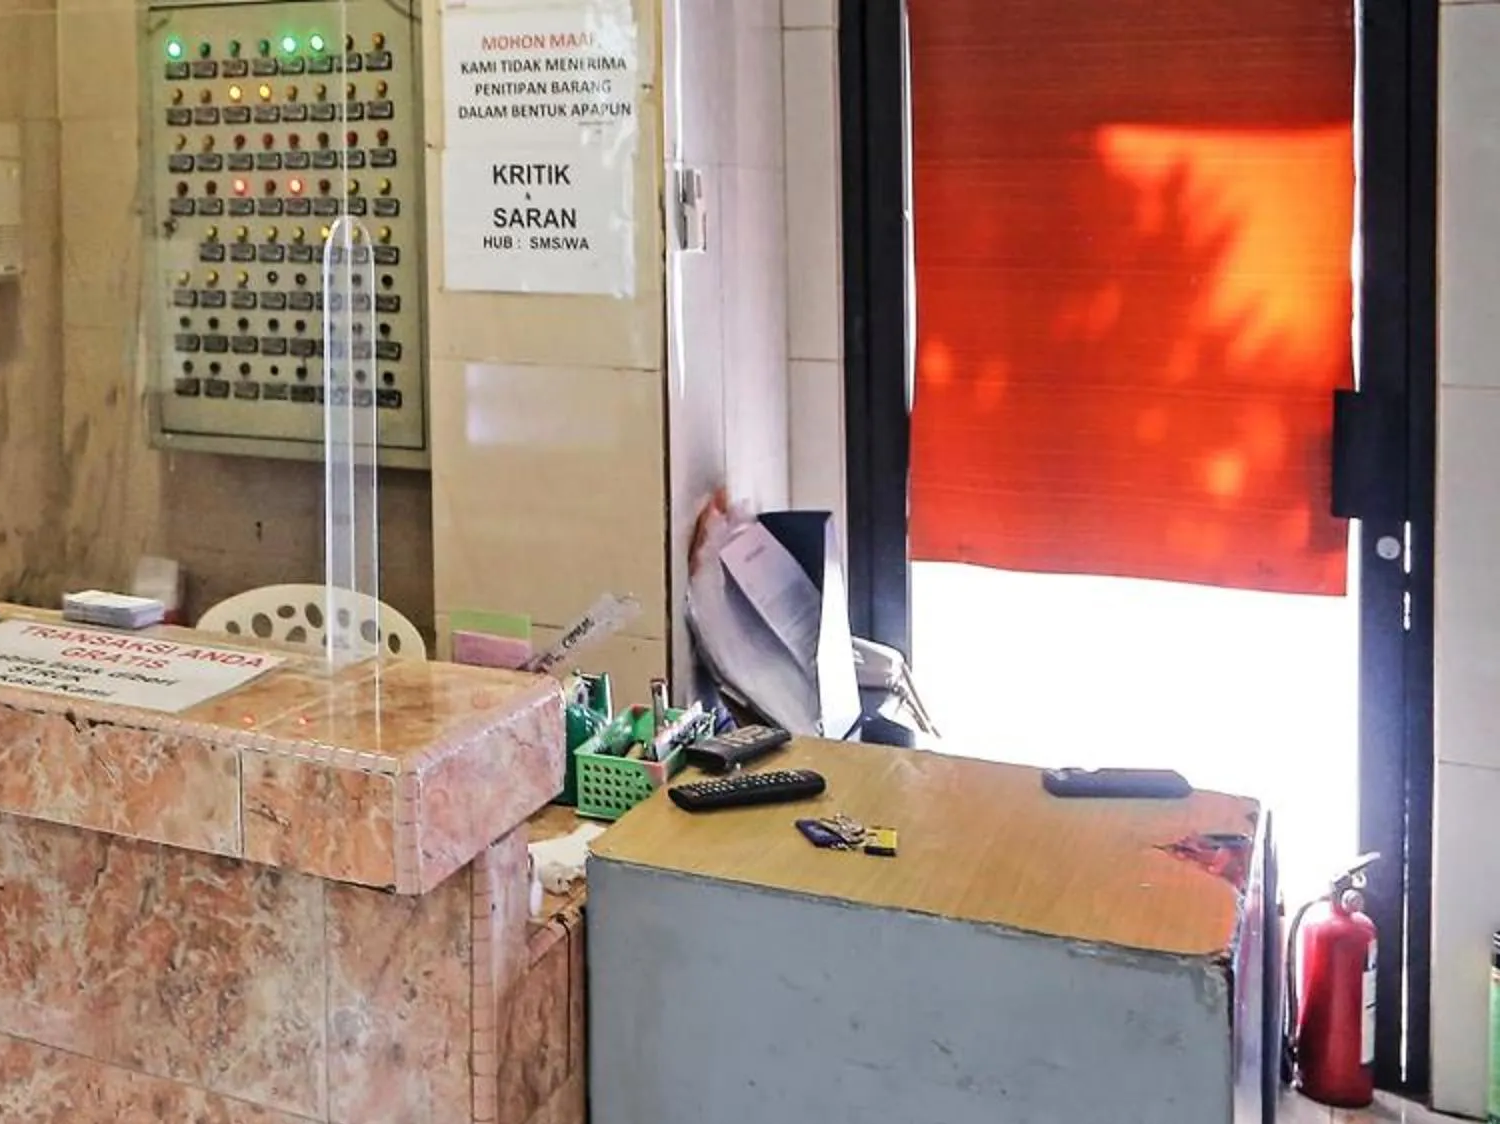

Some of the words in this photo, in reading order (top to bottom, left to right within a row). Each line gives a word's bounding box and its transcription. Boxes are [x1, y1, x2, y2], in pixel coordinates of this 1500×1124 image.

[482, 34, 546, 50] MOHON
[461, 59, 497, 74] KAMI
[501, 58, 542, 73] TIDAK
[475, 81, 547, 96] PENITIPAN
[551, 79, 612, 95] BARANG
[458, 104, 508, 119] DALAM
[512, 103, 567, 118] BENTUK
[571, 102, 632, 117] APAPUN
[493, 164, 571, 185] KRITIK
[493, 207, 577, 228] SARAN
[483, 236, 513, 249] HUB
[529, 236, 590, 250] SMS/WA
[20, 625, 179, 656] TRANSAKSI
[177, 649, 264, 669] ANDA
[61, 647, 170, 669] GRATIS
